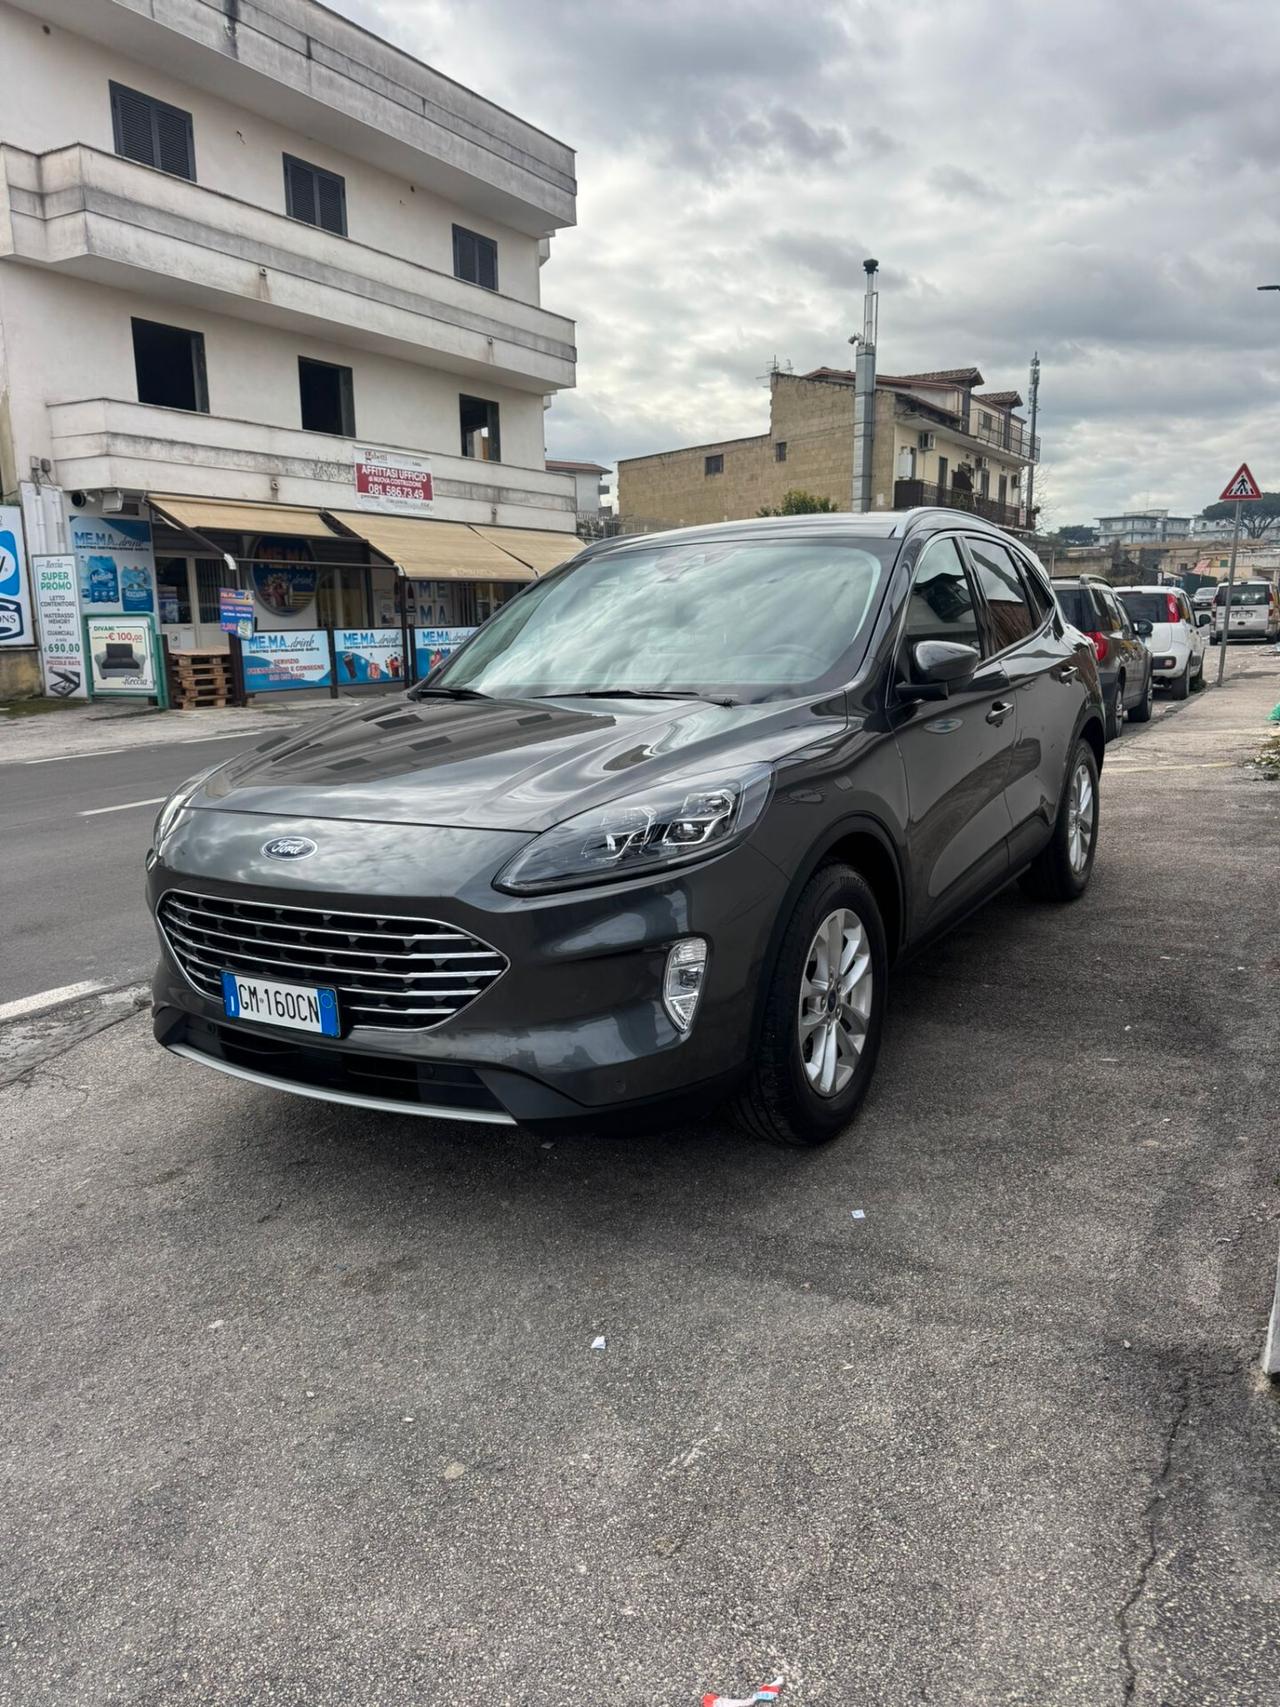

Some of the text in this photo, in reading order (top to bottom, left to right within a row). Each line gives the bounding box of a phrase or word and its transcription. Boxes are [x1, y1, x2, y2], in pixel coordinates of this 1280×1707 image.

[361, 465, 428, 482] AFFITTASI UFFICIO
[41, 572, 69, 581] SUPER
[40, 581, 72, 590] PROMO
[271, 840, 304, 854] Ford
